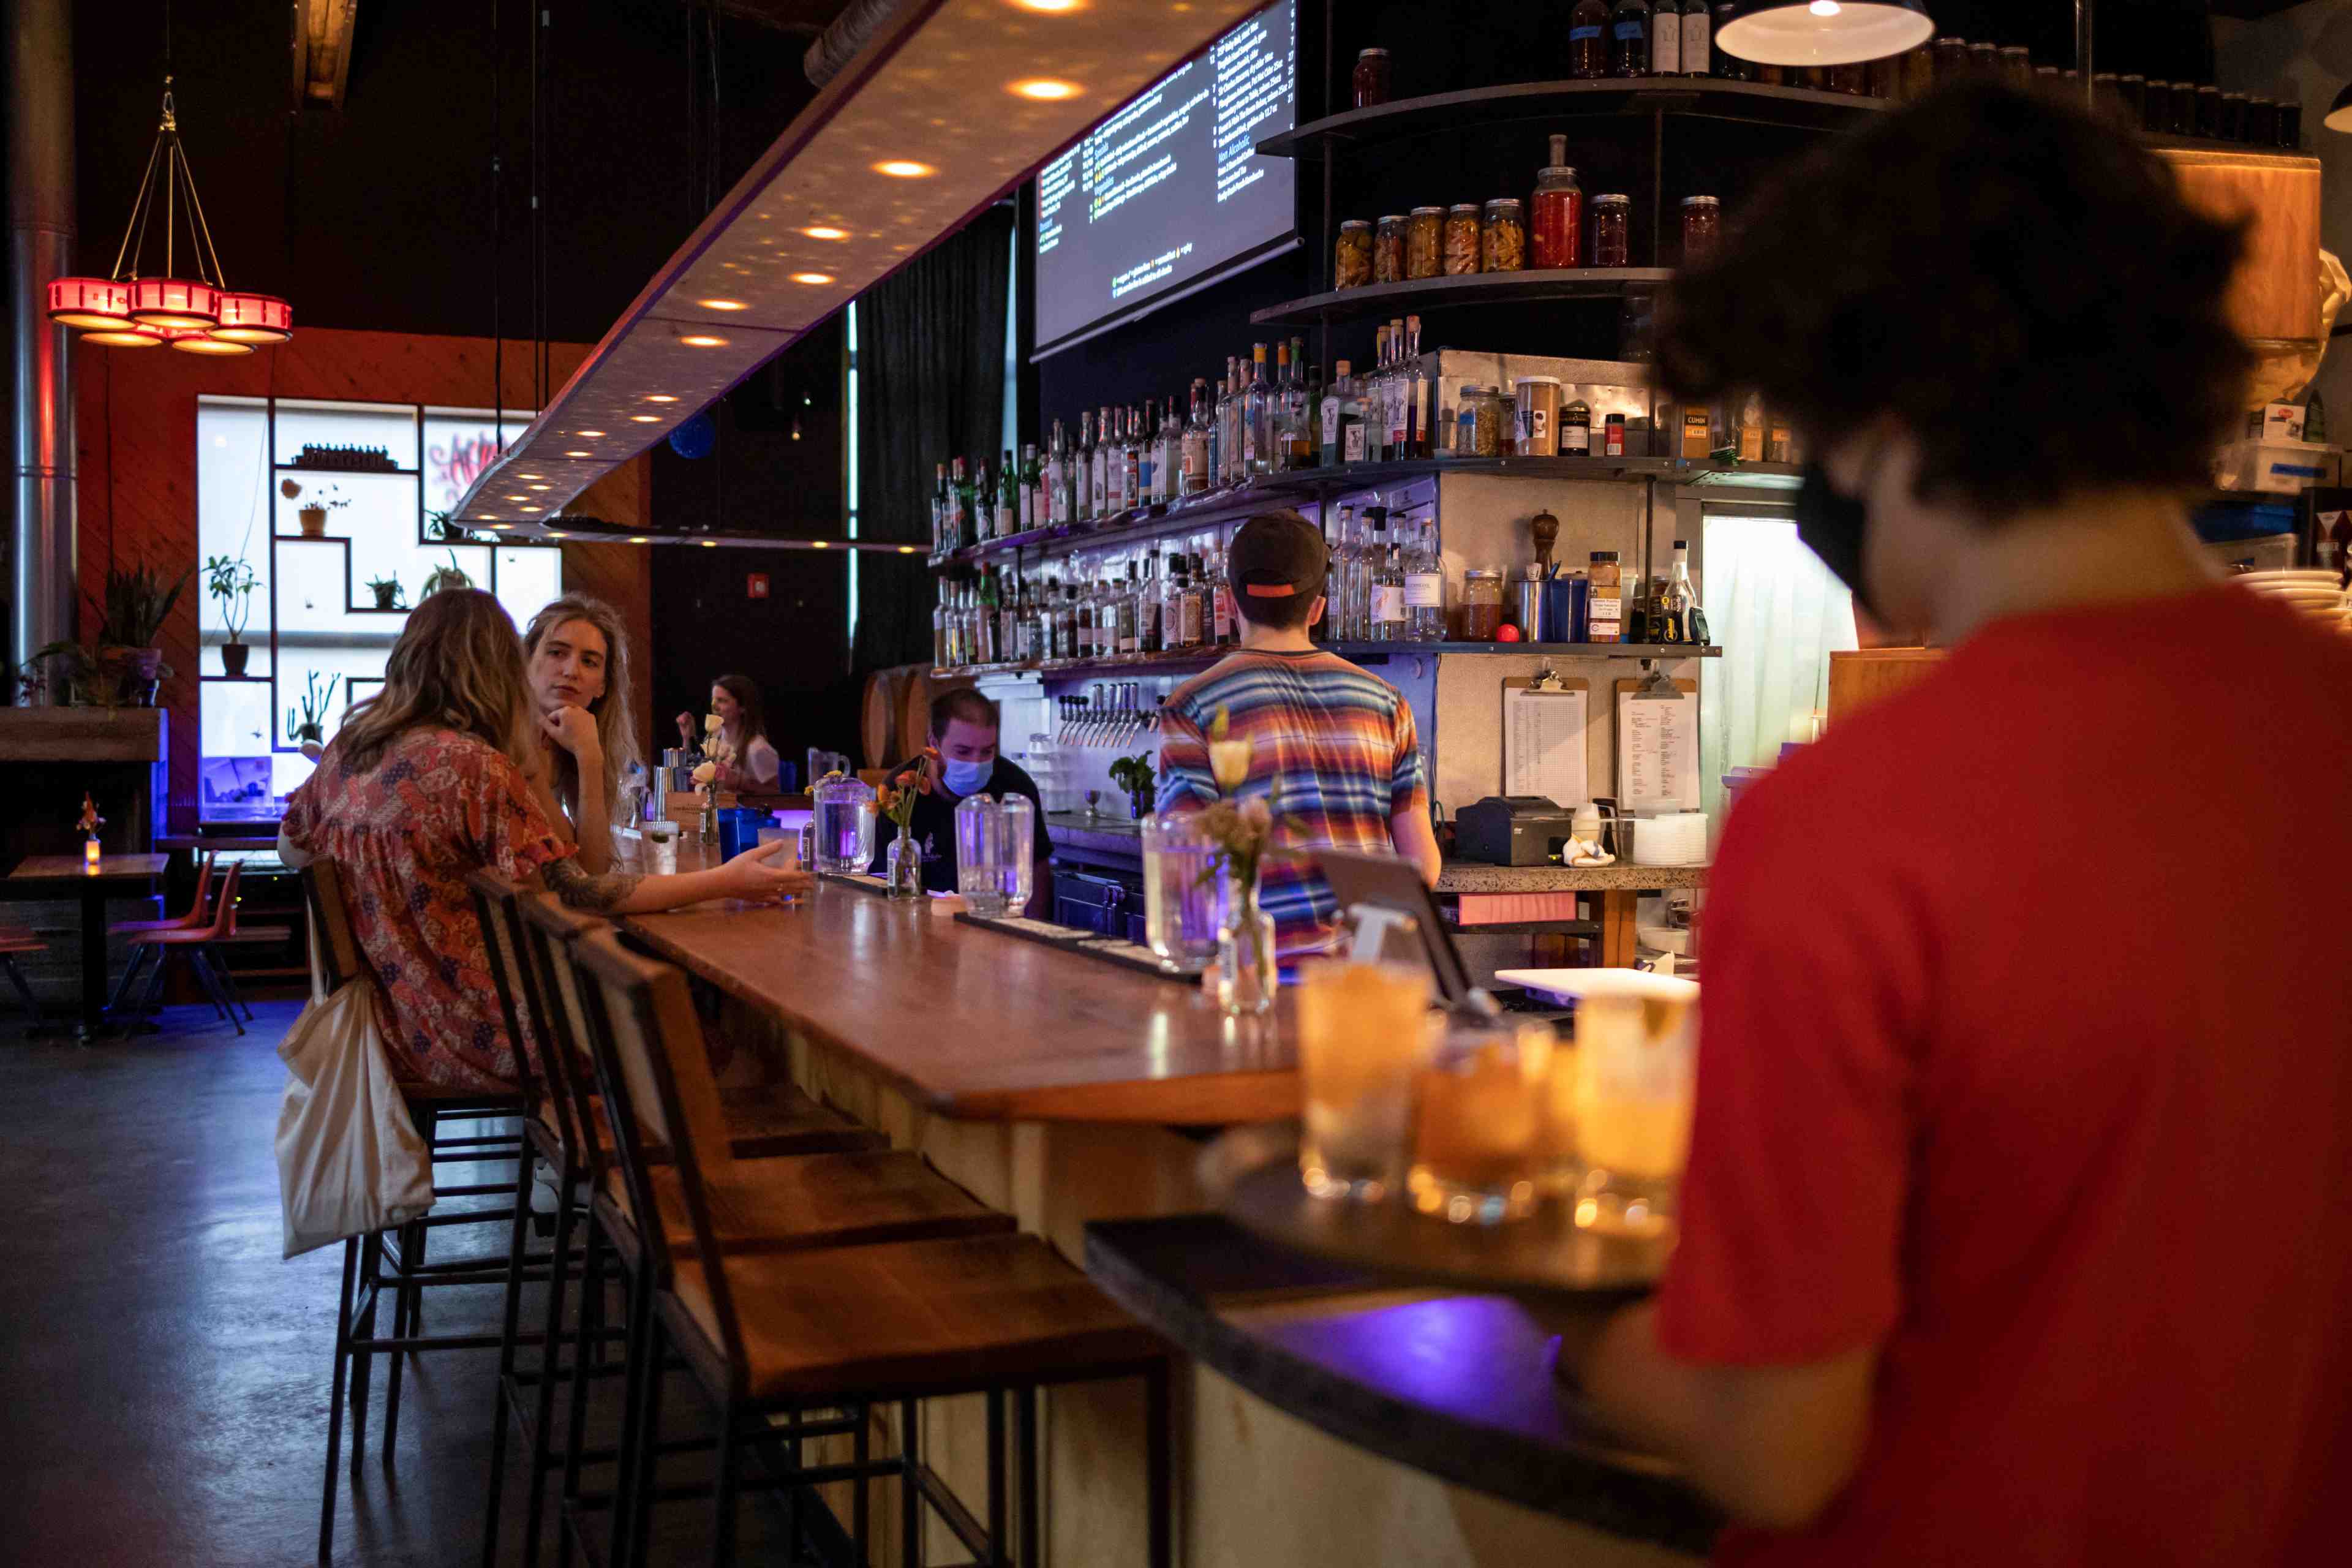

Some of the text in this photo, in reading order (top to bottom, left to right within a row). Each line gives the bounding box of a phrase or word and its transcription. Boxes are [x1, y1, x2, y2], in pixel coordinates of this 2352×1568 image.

[1288, 78, 1294, 89] 27
[1218, 151, 1228, 164] Non
[1229, 134, 1250, 158] Alcoholic
